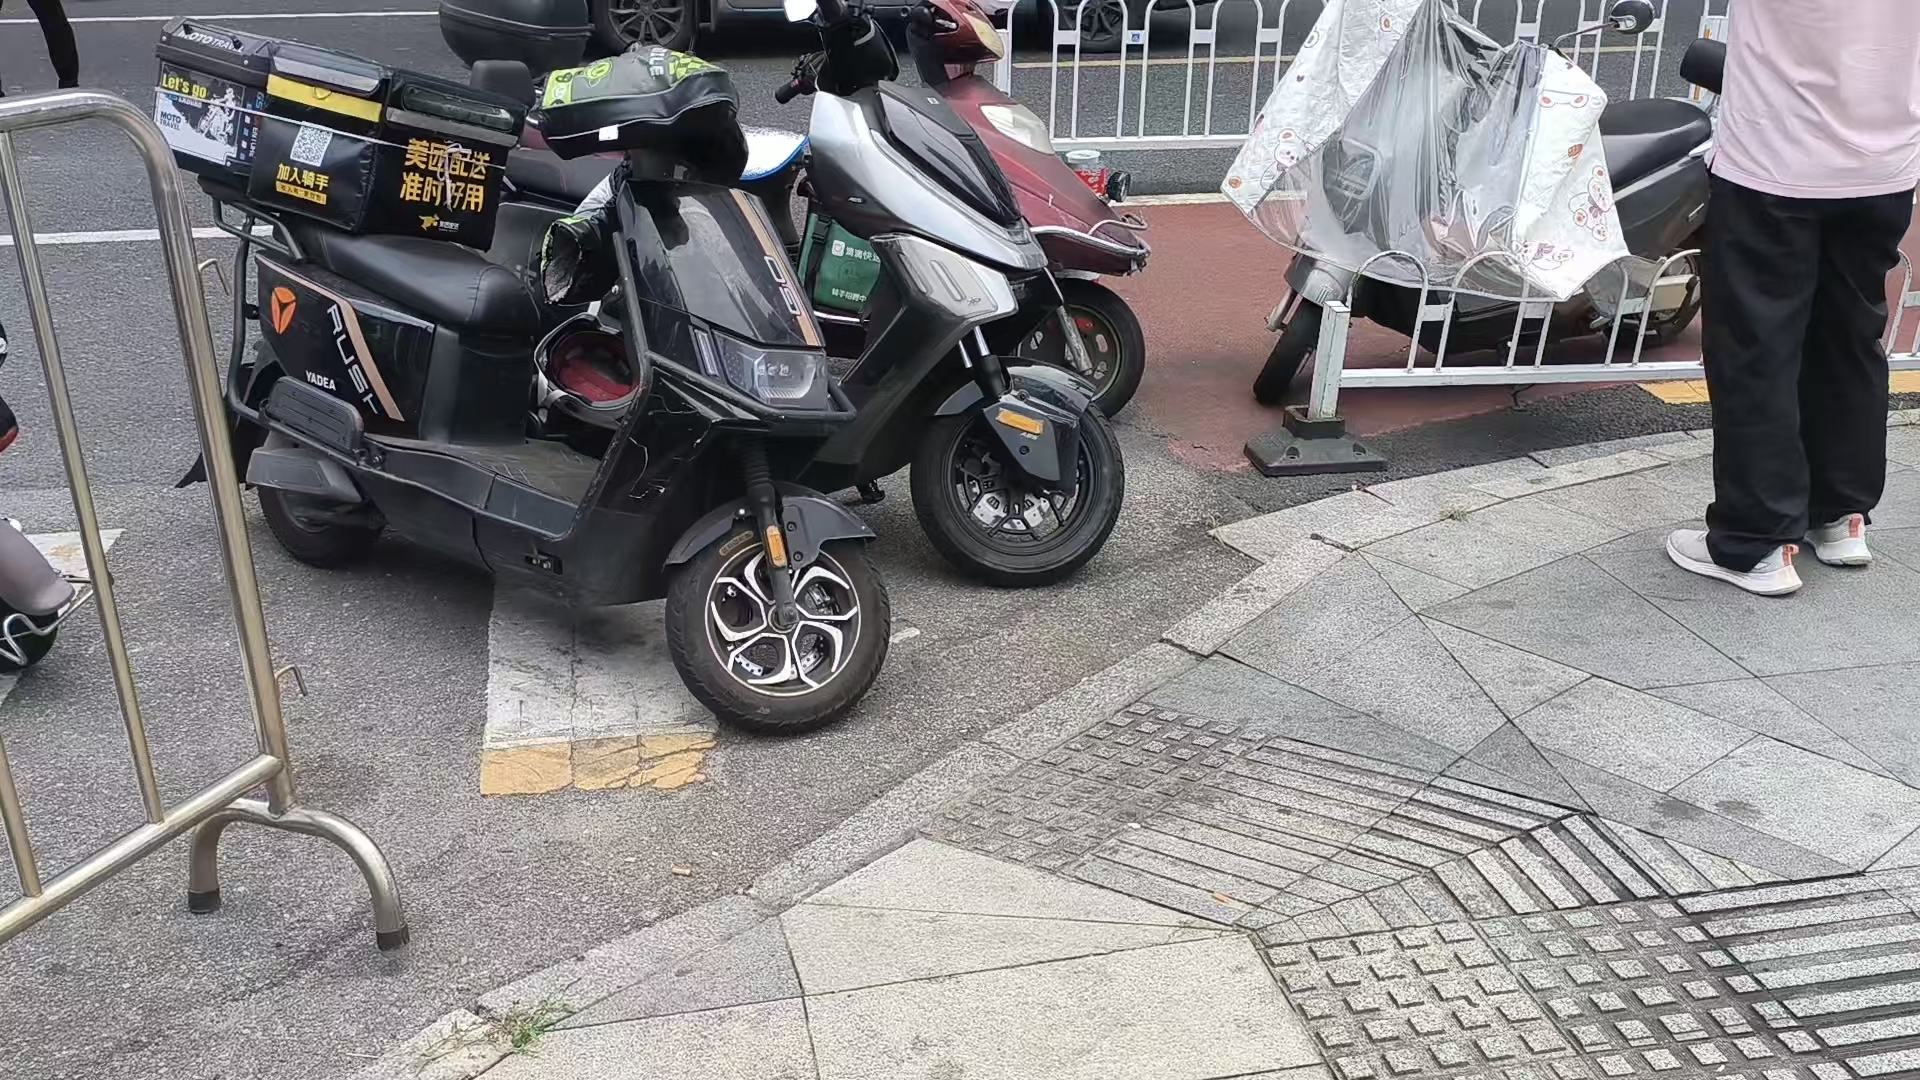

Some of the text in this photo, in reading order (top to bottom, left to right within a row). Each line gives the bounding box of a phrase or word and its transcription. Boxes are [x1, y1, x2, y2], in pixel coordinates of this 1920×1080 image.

[212, 38, 244, 53] TRAVL
[162, 73, 208, 99] Let's go
[160, 111, 182, 124] MOTO
[404, 138, 490, 180] 美团配送
[276, 163, 329, 191] 加入骑手
[400, 172, 484, 212] 准时好用
[327, 303, 379, 415] RUST
[305, 370, 336, 391] YADEA
